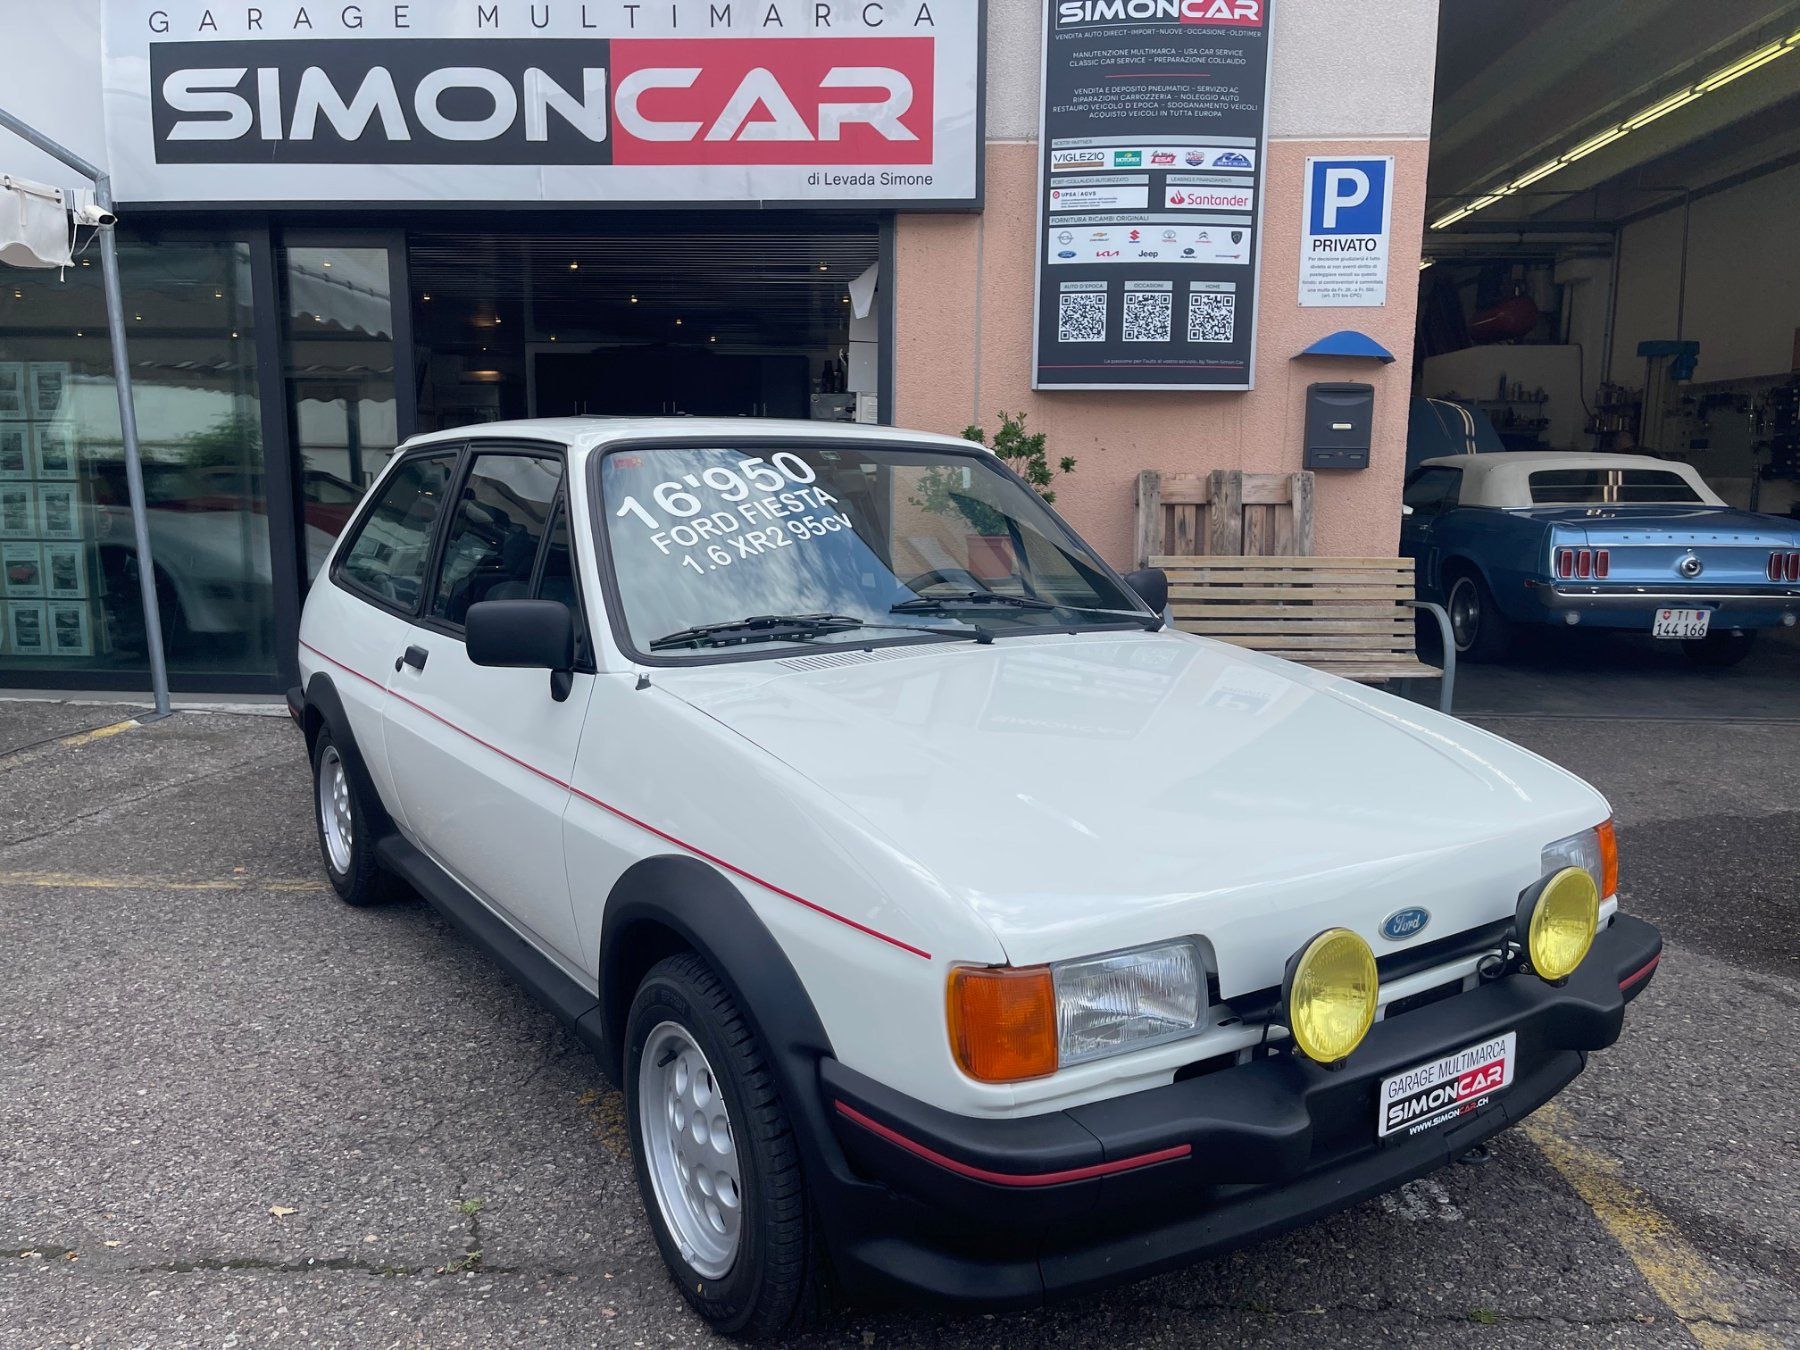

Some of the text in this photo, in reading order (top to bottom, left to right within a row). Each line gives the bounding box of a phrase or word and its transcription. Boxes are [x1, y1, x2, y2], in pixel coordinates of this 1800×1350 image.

[149, 2, 935, 34] GARAGE MULTIMARCA
[1059, 0, 1260, 24] SIMONCAR
[1055, 32, 1083, 40] VENDITA
[1084, 30, 1103, 38] AUTO
[1072, 49, 1129, 59] MANUTENZIONE
[1215, 48, 1244, 57] SERVICE
[1069, 59, 1099, 67] CLASSIC
[1116, 56, 1146, 65] SERVICE
[1154, 56, 1207, 64] PREPARAZIONE
[1207, 57, 1247, 65] COLLAUDO
[1073, 87, 1104, 95] VENDITA
[1111, 85, 1147, 93] DEPOSITO
[162, 65, 921, 143] SIMONCAR
[1072, 94, 1119, 103] RIPARAZIONI
[1120, 93, 1172, 101] CARROZZERIA
[1180, 93, 1219, 101] NOLEGGIO
[1052, 104, 1089, 113] RESTAURO
[1090, 102, 1124, 110] VEICOLO
[1230, 103, 1258, 111] VEICOLI
[1088, 110, 1127, 118] ACQUISTO
[1053, 151, 1105, 163] VIGLEZIO
[807, 172, 933, 186] di Levada Simone
[1187, 193, 1249, 207] Santander
[1322, 168, 1370, 229] P
[1050, 216, 1087, 224] FORNITURA
[1312, 238, 1377, 252] PRIVATO
[1138, 249, 1159, 259] Jeep
[615, 452, 816, 530] 16'950
[650, 485, 839, 556] FORD FIESTA
[682, 544, 732, 575] 1.6
[730, 526, 793, 560] XR2
[1677, 610, 1688, 621] TI
[1656, 622, 1705, 637] 144 166
[1392, 910, 1421, 934] Ford
[1388, 1039, 1506, 1099] GARAGE MULTIMARCA
[1387, 1065, 1502, 1126] SIMONCAR
